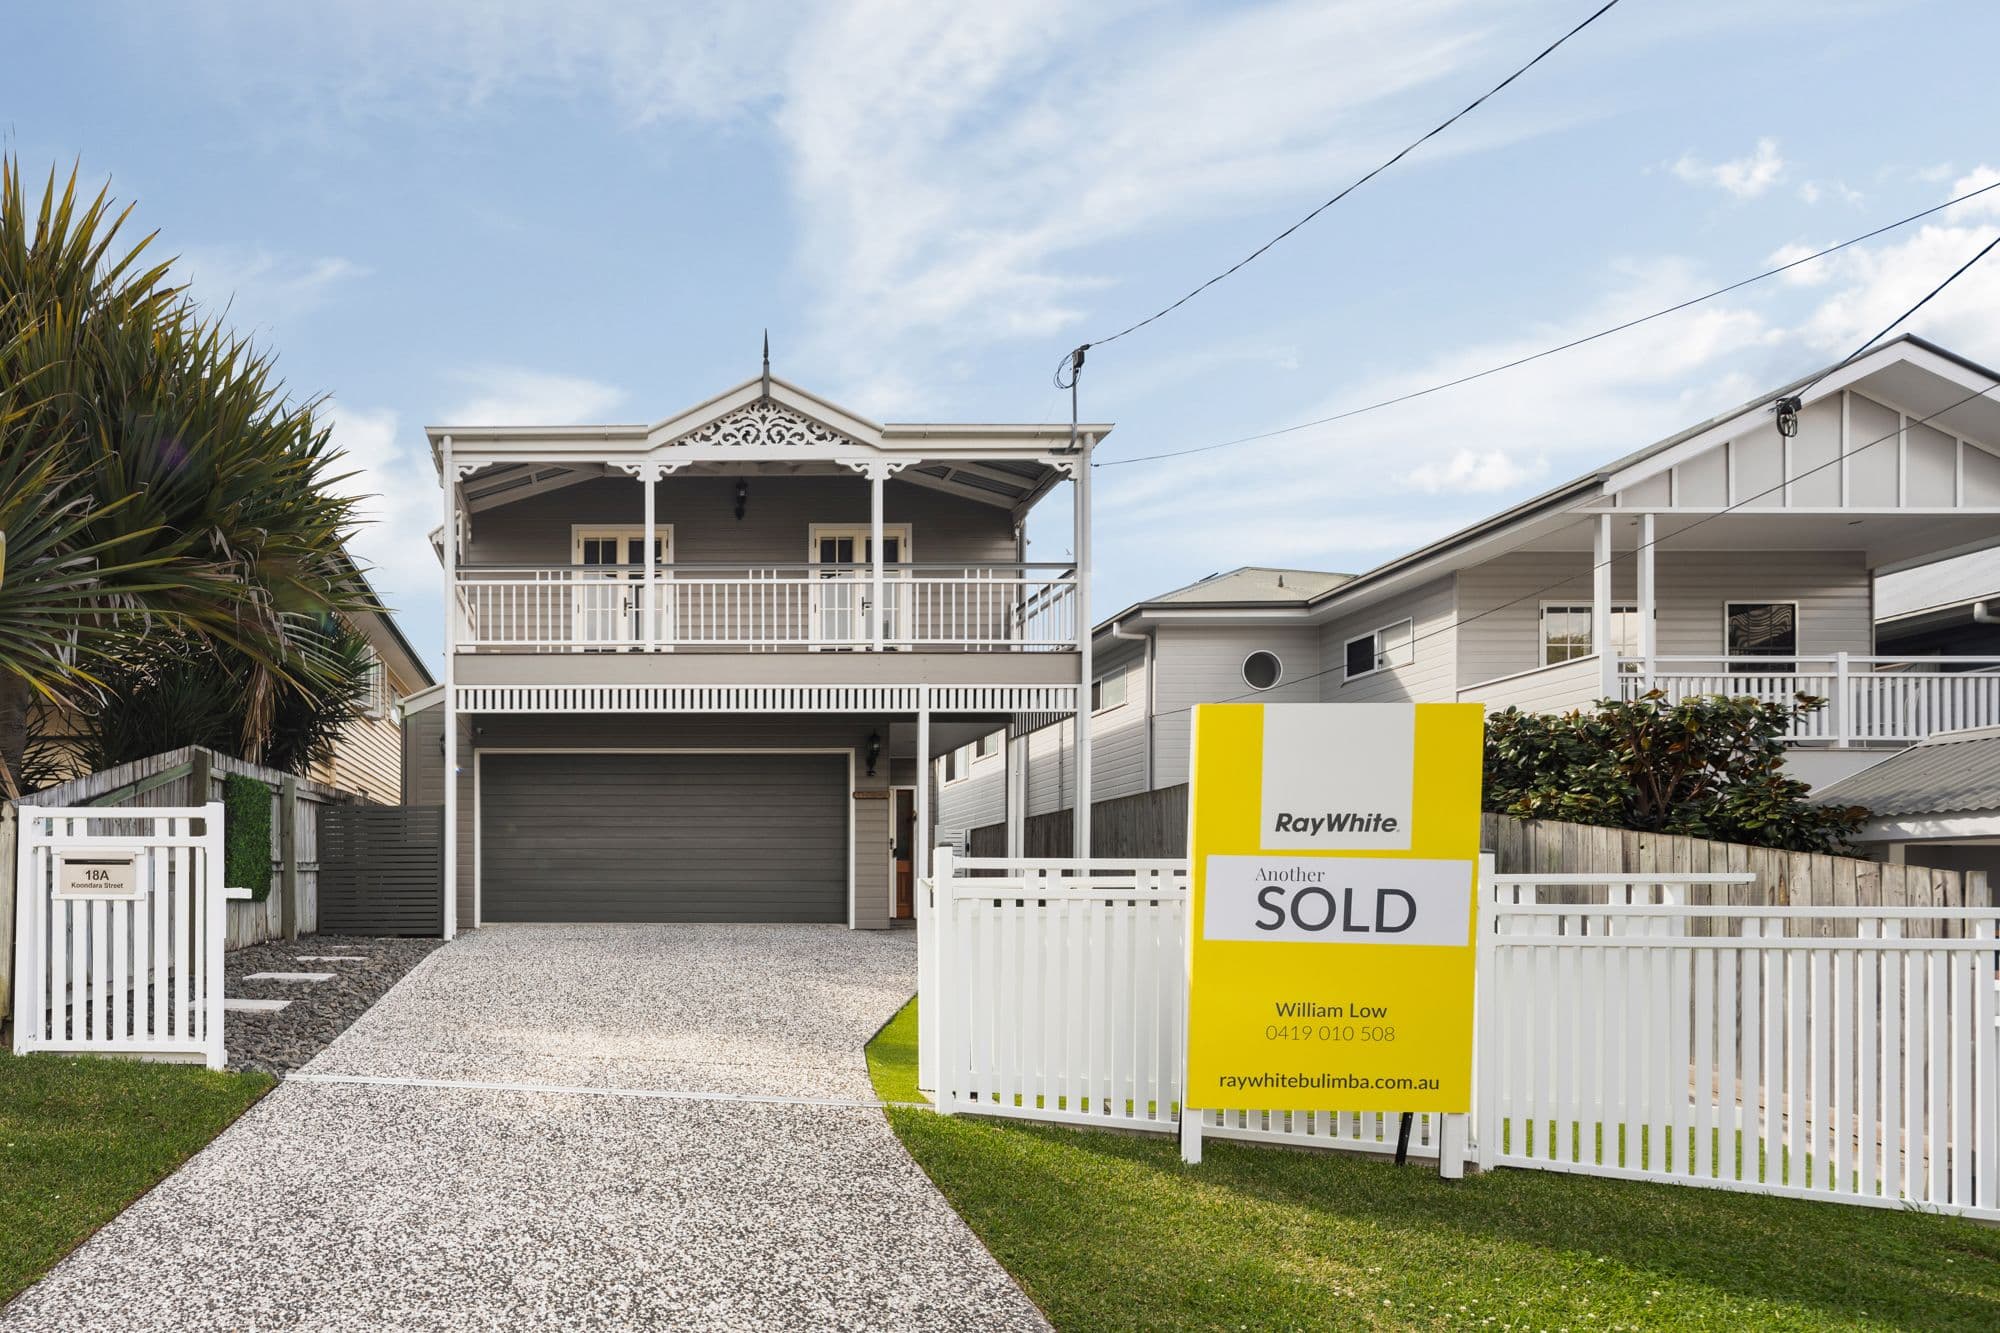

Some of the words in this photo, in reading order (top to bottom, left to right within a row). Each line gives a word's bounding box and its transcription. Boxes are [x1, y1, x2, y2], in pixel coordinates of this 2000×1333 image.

[85, 869, 110, 881] 18A
[1255, 866, 1325, 883] Another
[1255, 885, 1417, 934] SOLD
[1275, 1001, 1343, 1018] William
[1349, 1002, 1388, 1019] Low
[1265, 1024, 1313, 1041] 0419
[1318, 1025, 1355, 1041] 010
[1360, 1026, 1396, 1042] 508
[1219, 1072, 1440, 1091] raywhitebulimba.com.au
